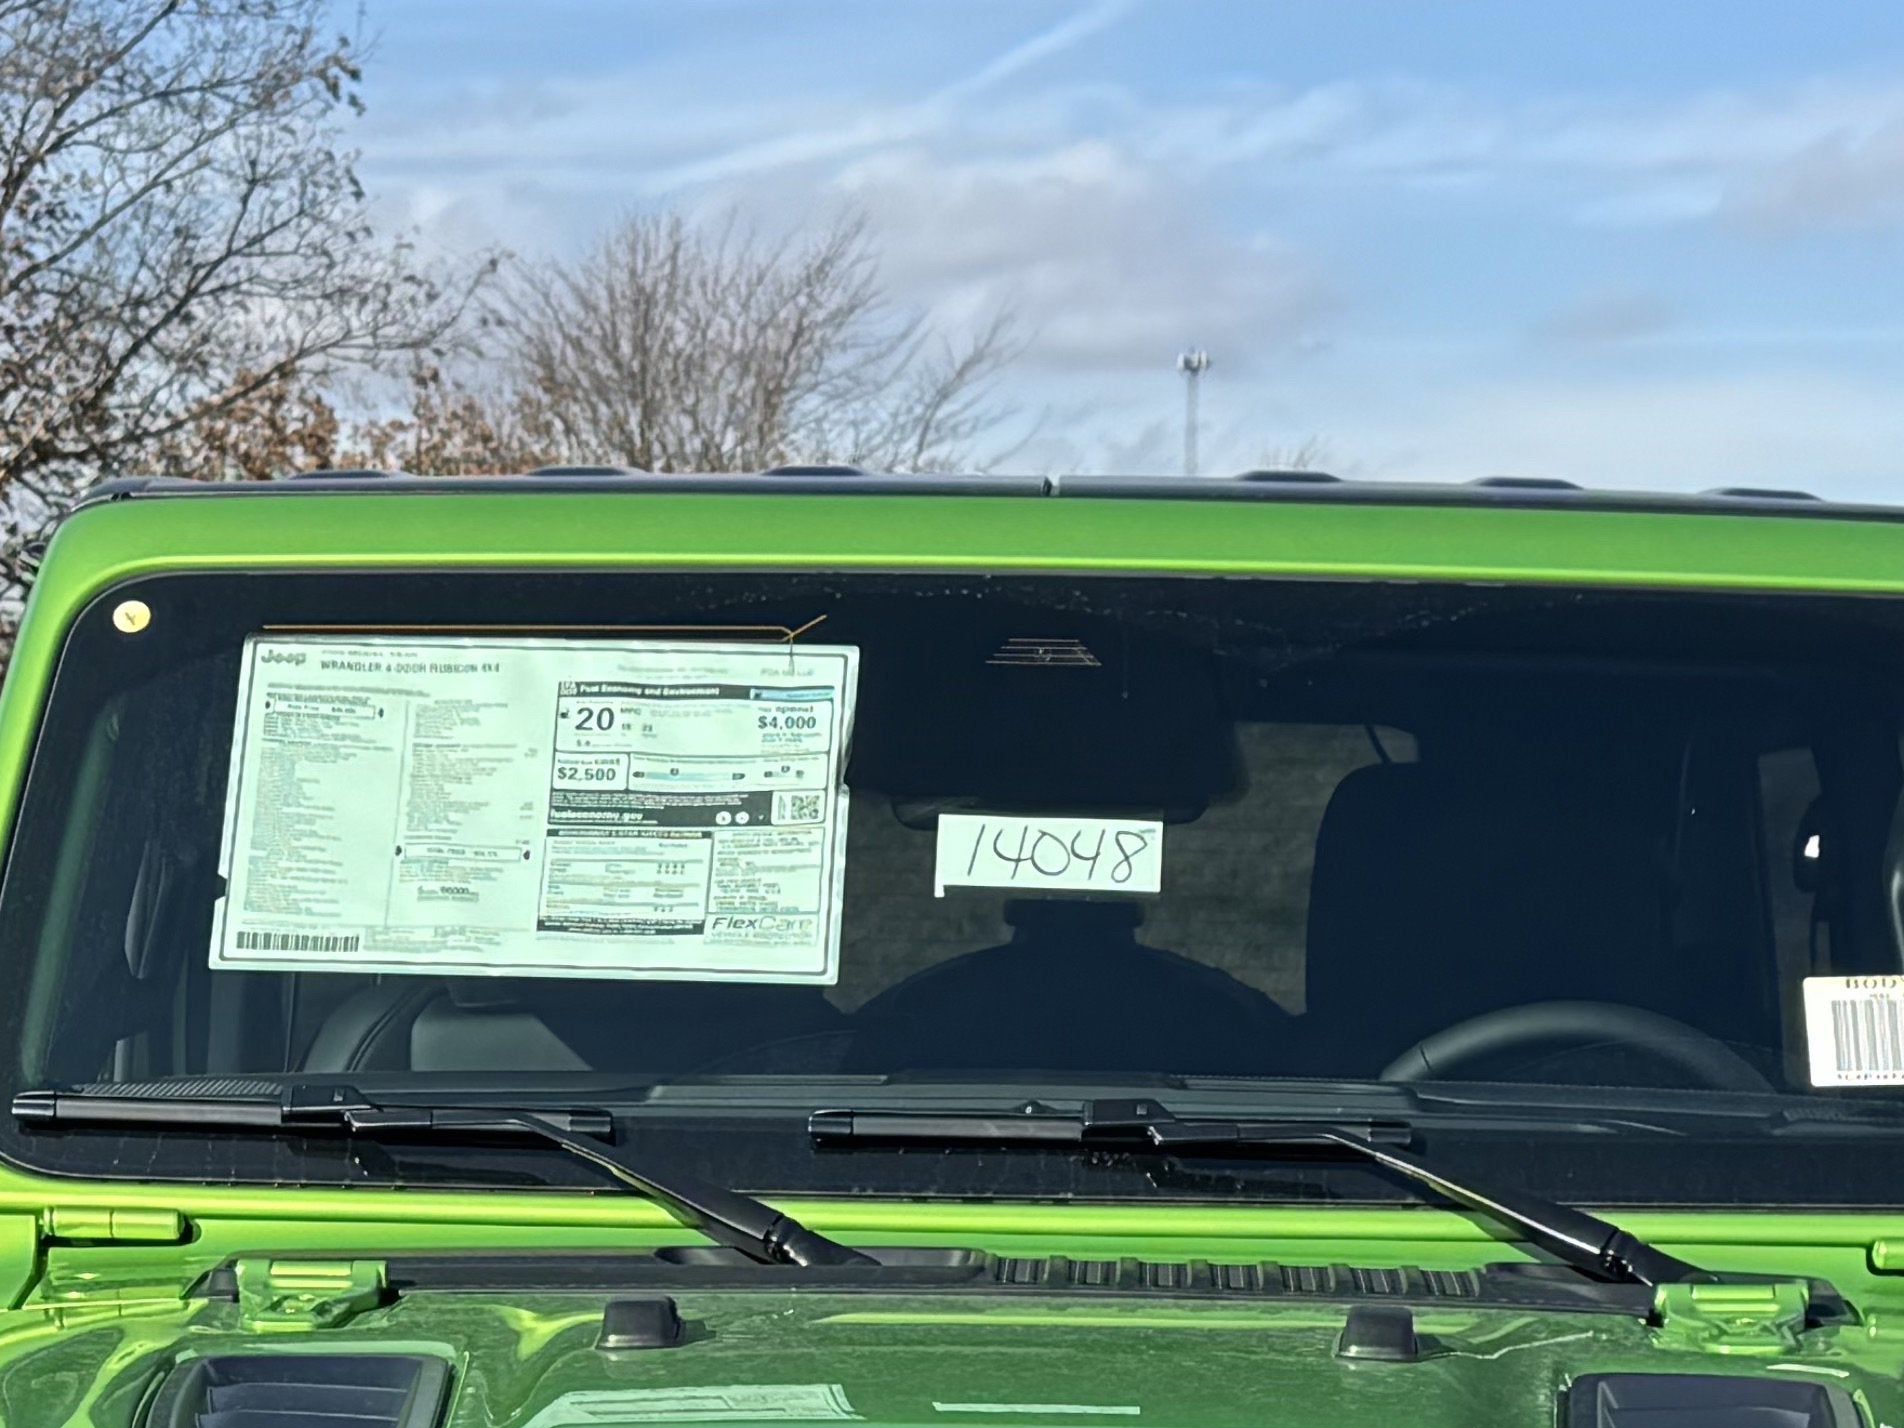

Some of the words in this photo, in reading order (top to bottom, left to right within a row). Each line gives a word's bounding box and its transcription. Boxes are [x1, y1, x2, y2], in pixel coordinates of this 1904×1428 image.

[261, 649, 307, 666] Jeep
[320, 660, 383, 673] WRANGLER
[574, 706, 615, 732] 20
[757, 714, 817, 731] $4,000
[557, 766, 616, 782] $2,500
[967, 823, 1147, 884] 14048
[712, 914, 813, 932] FlexCare
